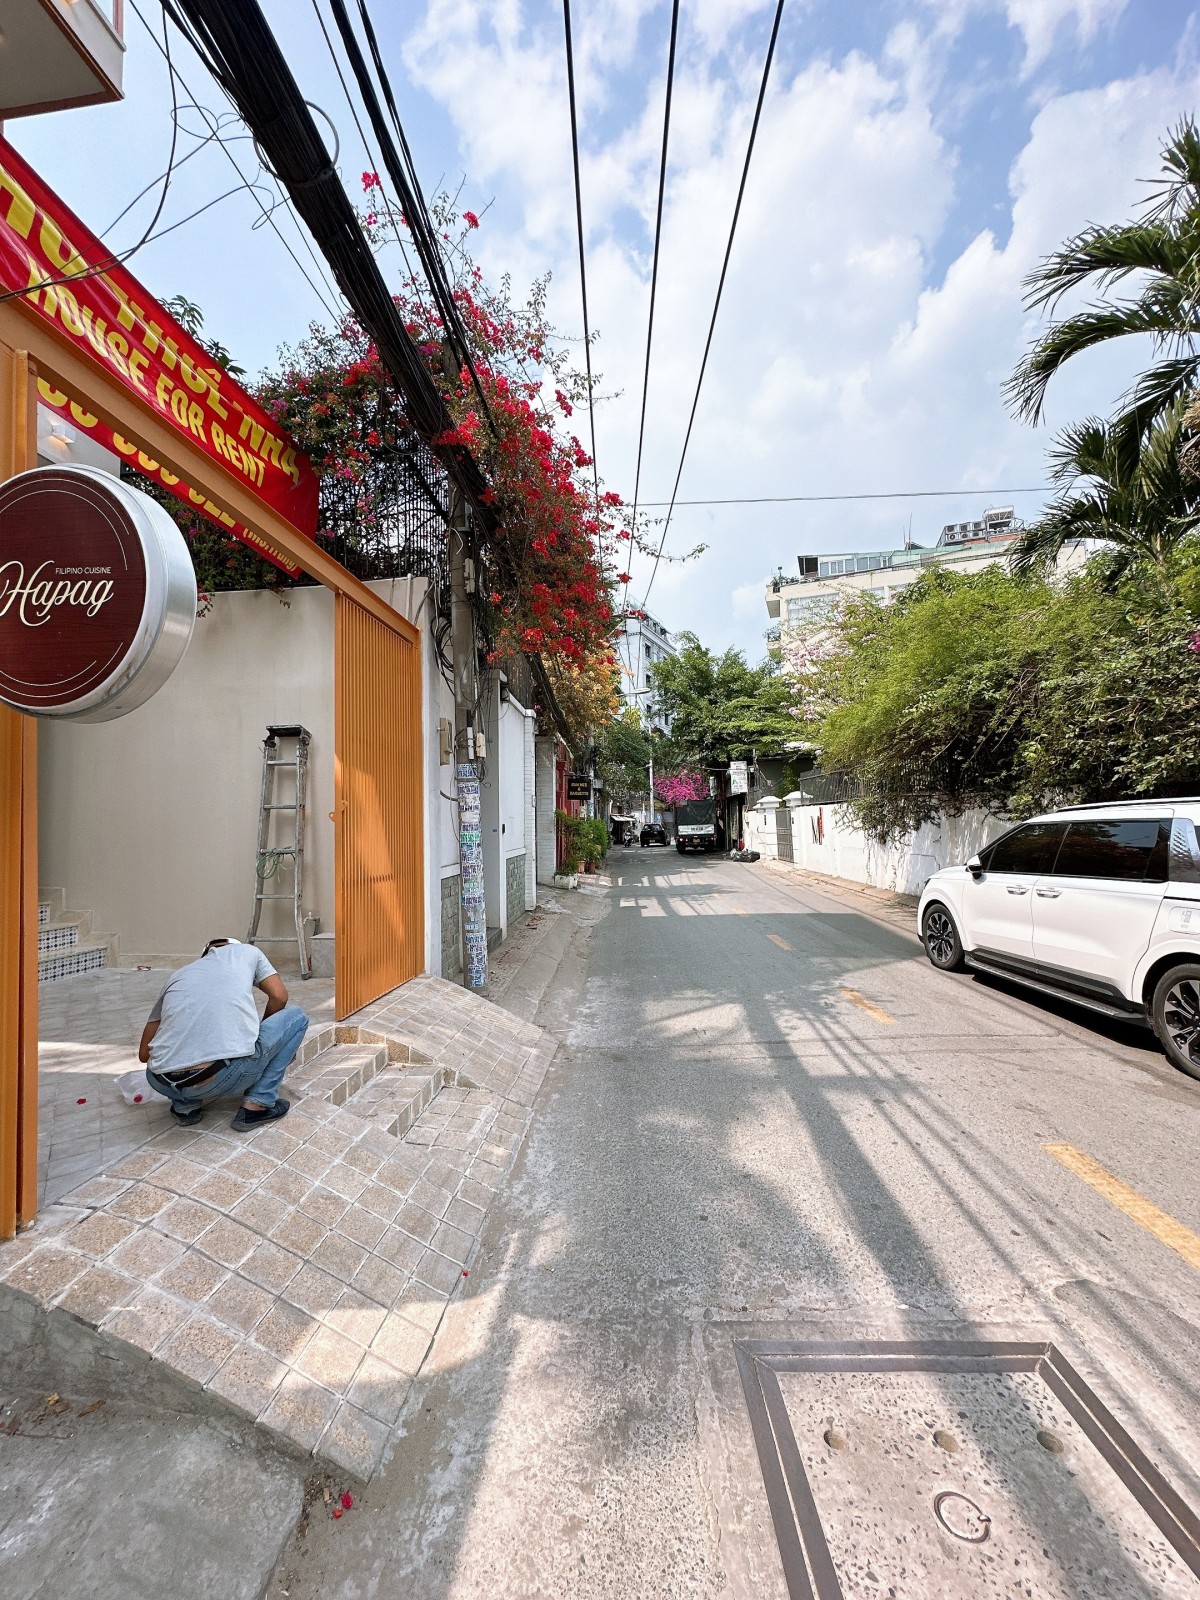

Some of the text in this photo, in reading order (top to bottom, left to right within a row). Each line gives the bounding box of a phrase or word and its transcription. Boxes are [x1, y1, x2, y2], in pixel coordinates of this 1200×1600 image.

[26, 252, 150, 396] HOUSE
[155, 371, 209, 444] FOR
[210, 420, 267, 488] RENT
[0, 560, 115, 627] Hapag
[55, 566, 112, 575] FILIPINO CUISINE
